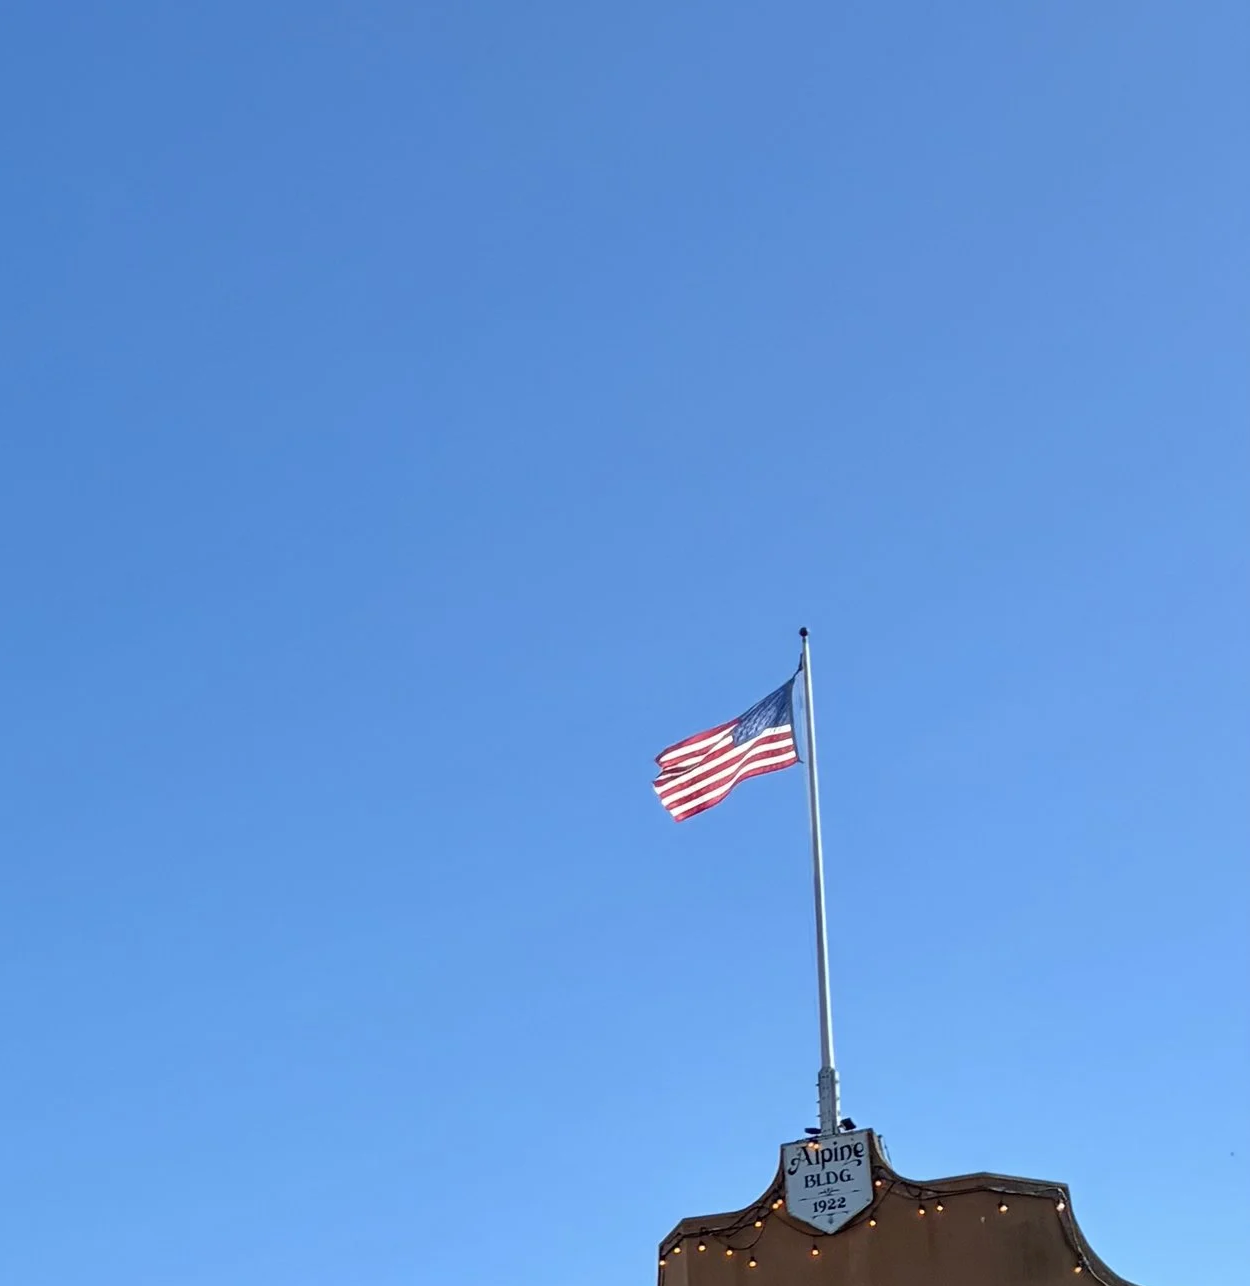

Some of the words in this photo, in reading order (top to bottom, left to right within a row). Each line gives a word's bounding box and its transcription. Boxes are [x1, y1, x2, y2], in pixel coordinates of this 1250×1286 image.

[788, 1141, 864, 1176] Alpine
[804, 1169, 854, 1188] BLDG
[813, 1196, 847, 1214] 1922
